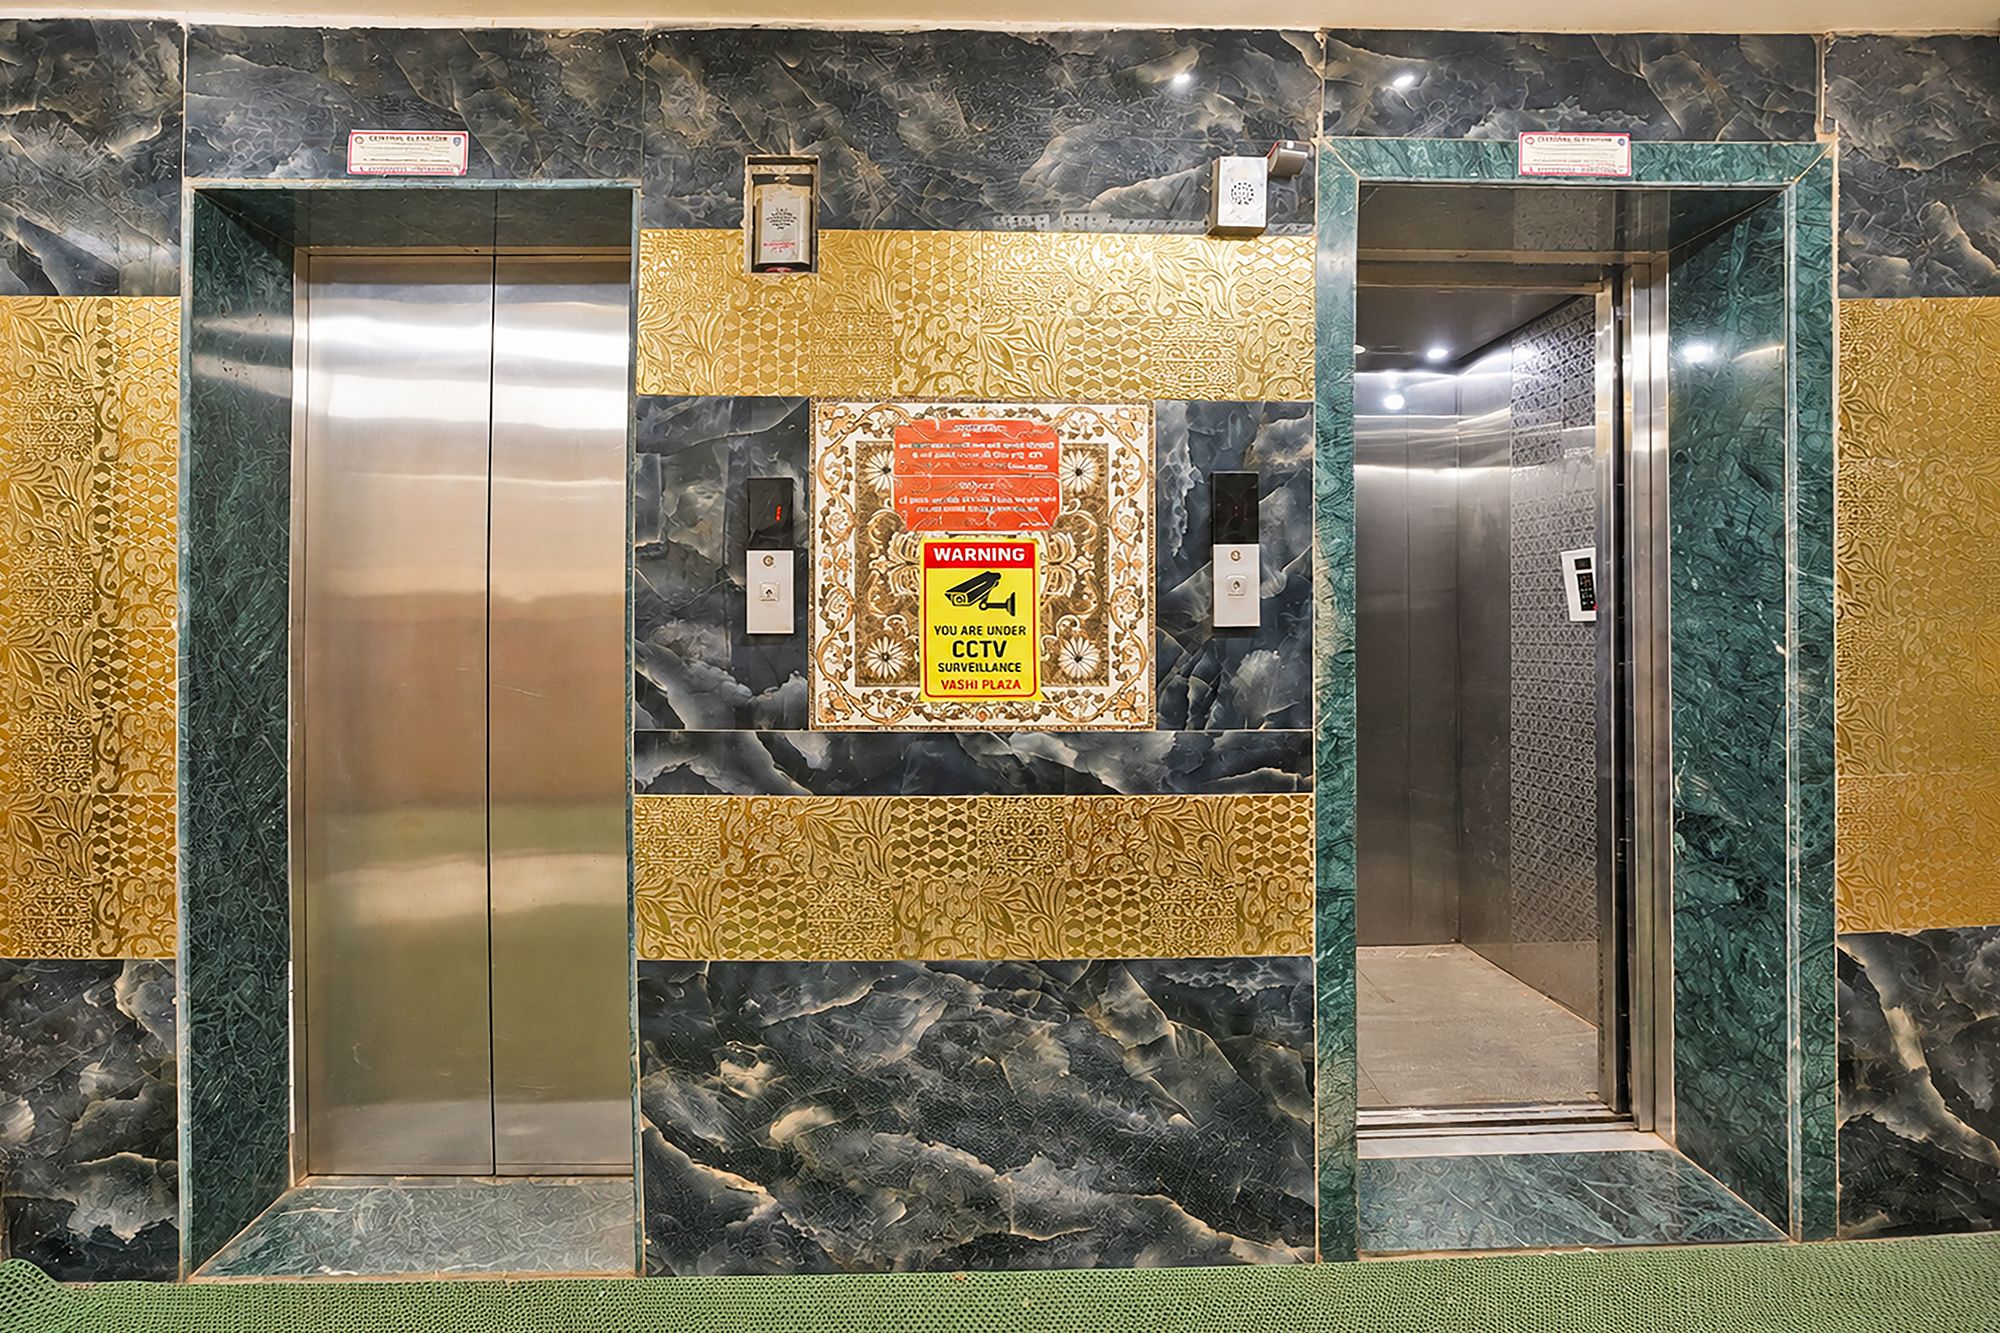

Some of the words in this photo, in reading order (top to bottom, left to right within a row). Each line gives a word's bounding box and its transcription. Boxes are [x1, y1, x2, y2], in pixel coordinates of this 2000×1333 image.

[933, 547, 1025, 561] WARNING
[934, 625, 957, 636] YOU
[960, 625, 983, 636] ARE
[987, 625, 1027, 636] UNDER
[952, 640, 1007, 658] CCTV
[938, 662, 1022, 673] SURVEILLANCE
[940, 679, 978, 690] VASHI
[982, 679, 1021, 690] PLAZA
